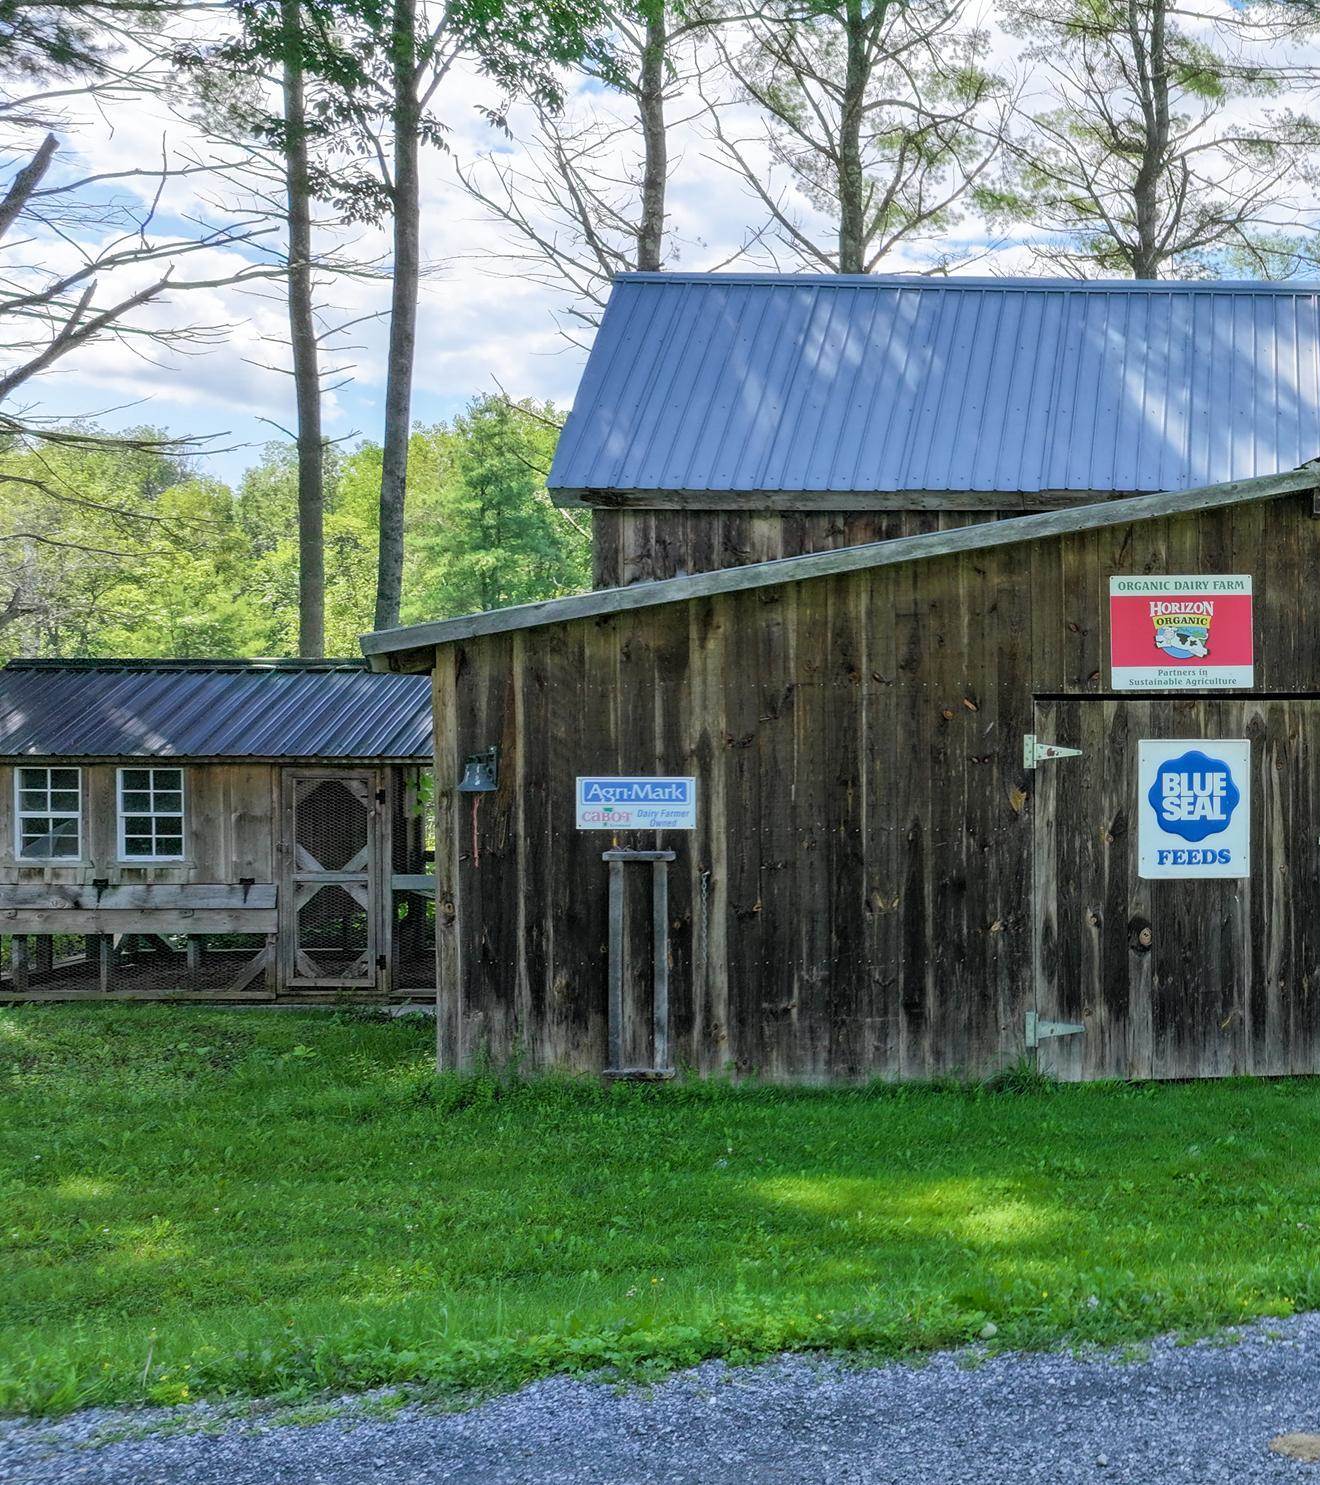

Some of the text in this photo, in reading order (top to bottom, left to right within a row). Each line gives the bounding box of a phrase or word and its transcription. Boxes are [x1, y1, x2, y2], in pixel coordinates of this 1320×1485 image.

[1118, 580, 1245, 591] ORGANIC DAIRY FARM
[1149, 601, 1214, 617] HORIZON
[1156, 617, 1208, 626] ORGANIC
[1158, 669, 1196, 677] Partners
[1128, 677, 1237, 687] Sustainable Agriculture
[1162, 772, 1227, 797] BLUE
[637, 809, 690, 818] Dairy Farmer
[1162, 797, 1227, 821] SEAL
[649, 818, 678, 828] Owned
[1157, 849, 1231, 865] FEEDS
